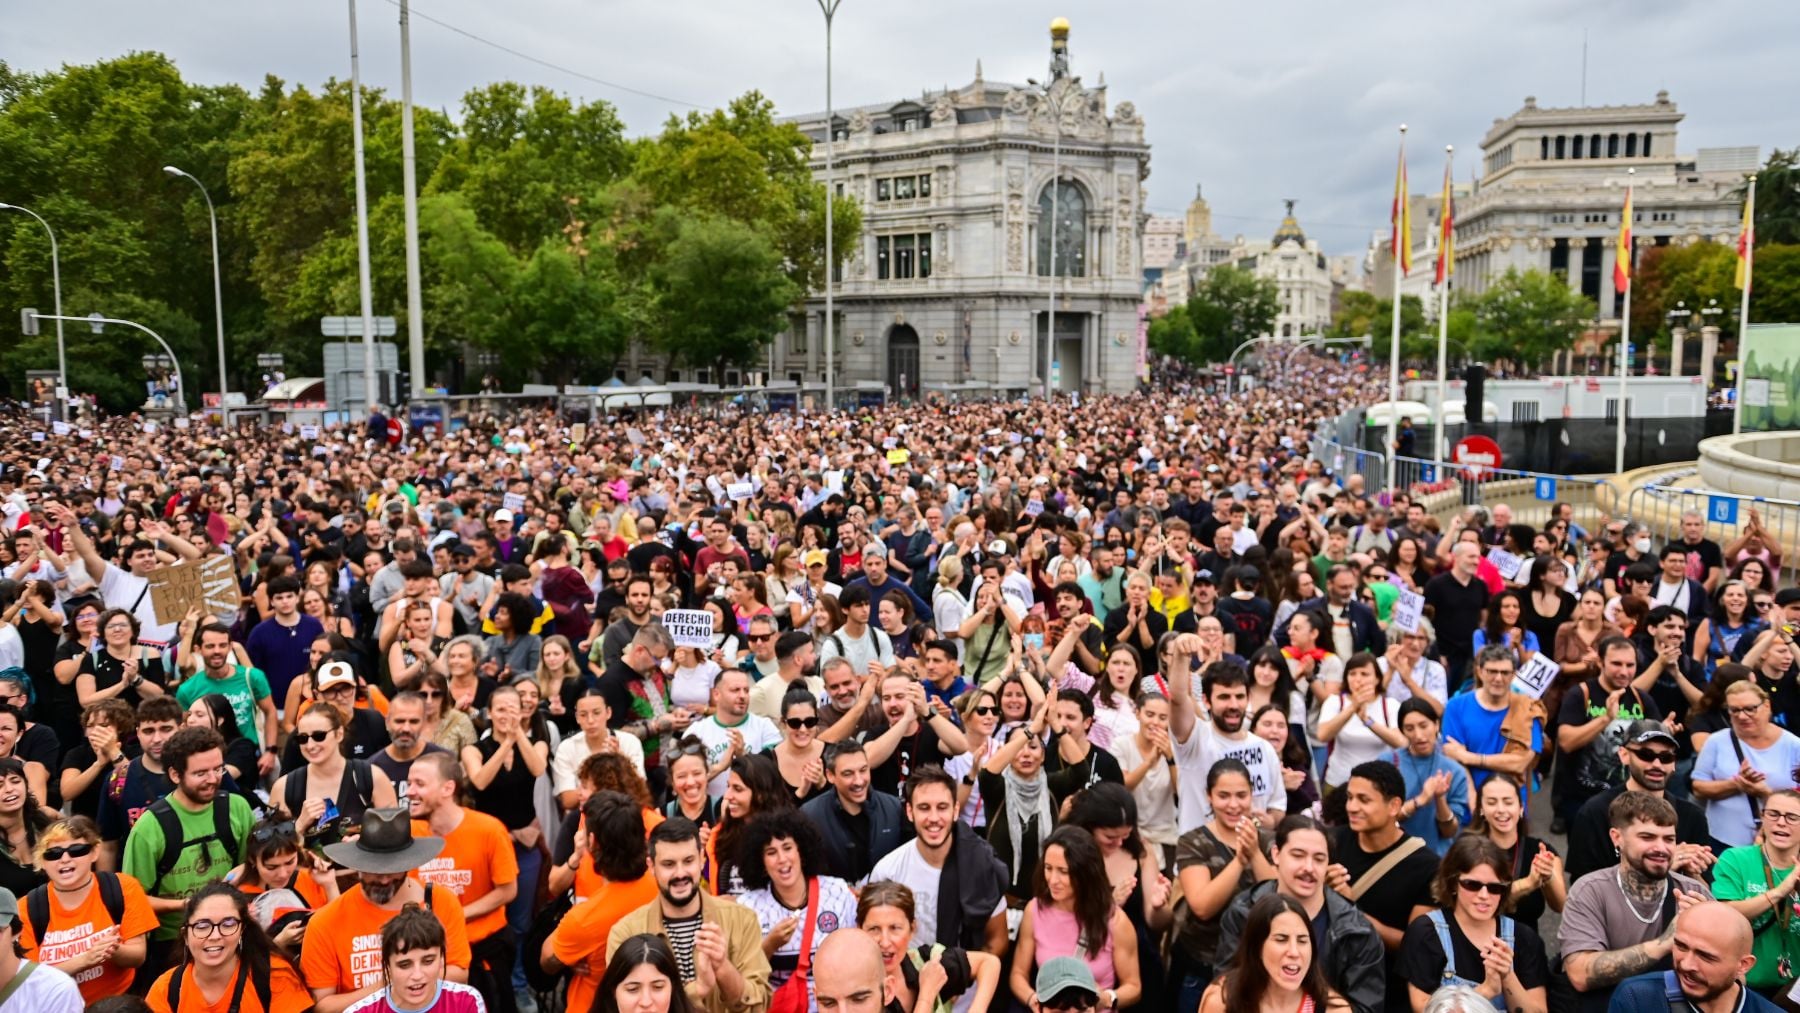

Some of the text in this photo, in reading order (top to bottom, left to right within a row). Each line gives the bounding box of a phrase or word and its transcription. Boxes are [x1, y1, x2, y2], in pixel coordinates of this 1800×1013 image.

[665, 613, 711, 625] DERECHO
[674, 625, 710, 637] TECHO
[1520, 659, 1554, 688] TA!
[44, 922, 93, 945] SINDICATO
[41, 948, 53, 962] DE
[353, 954, 367, 971] DE
[76, 965, 104, 984] DRID
